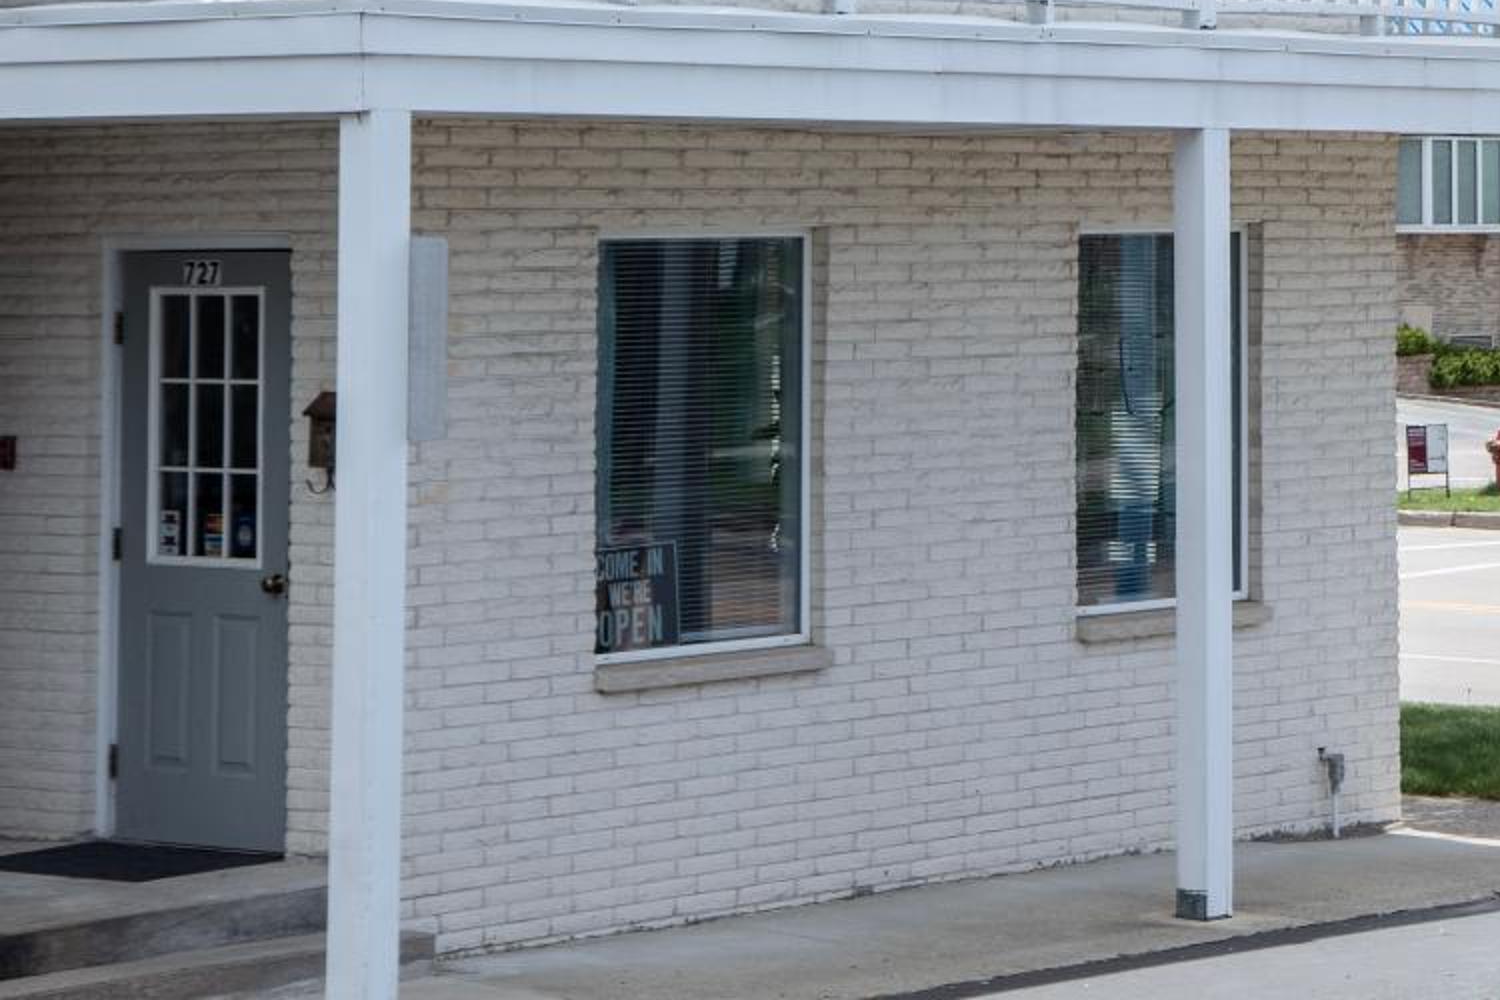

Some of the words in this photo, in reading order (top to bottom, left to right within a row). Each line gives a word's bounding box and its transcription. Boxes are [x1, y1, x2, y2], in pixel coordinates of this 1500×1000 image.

[184, 261, 219, 285] 727
[647, 547, 664, 576] IN
[599, 603, 663, 647] OPEN
